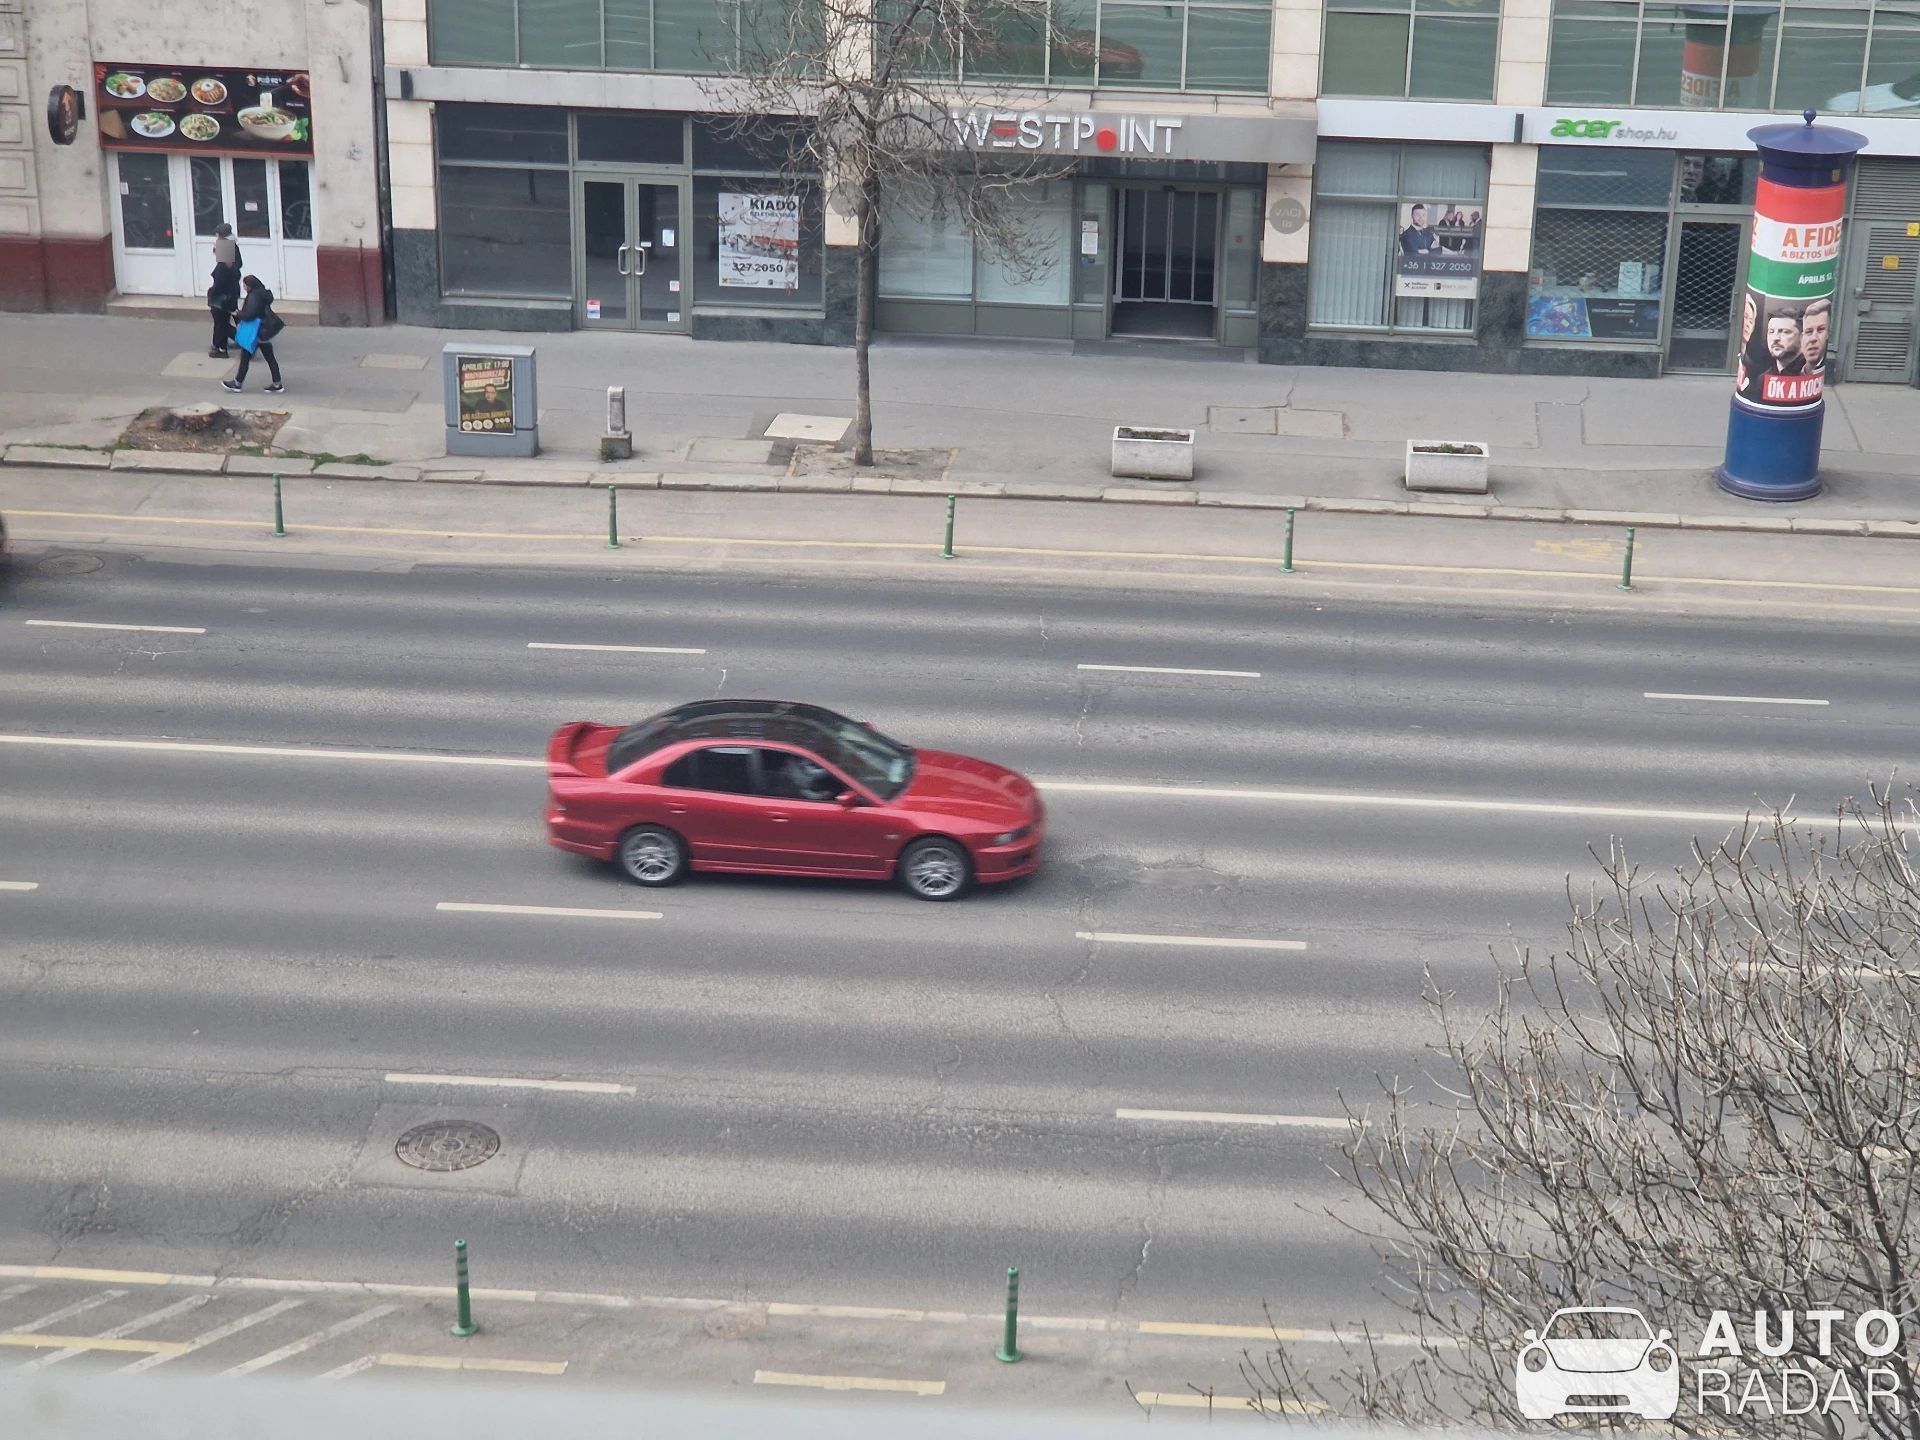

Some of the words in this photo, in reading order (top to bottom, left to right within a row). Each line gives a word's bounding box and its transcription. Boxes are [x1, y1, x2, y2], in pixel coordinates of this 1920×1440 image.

[1550, 118, 1622, 138] acer
[1615, 127, 1678, 142] shop.hu
[1782, 227, 1799, 248] A
[1781, 250, 1788, 258] A
[1790, 250, 1822, 260] BIZTOS
[1430, 262, 1446, 270] 327
[1449, 263, 1472, 272] 2050
[1767, 376, 1785, 398] ŐK
[1787, 382, 1797, 398] A
